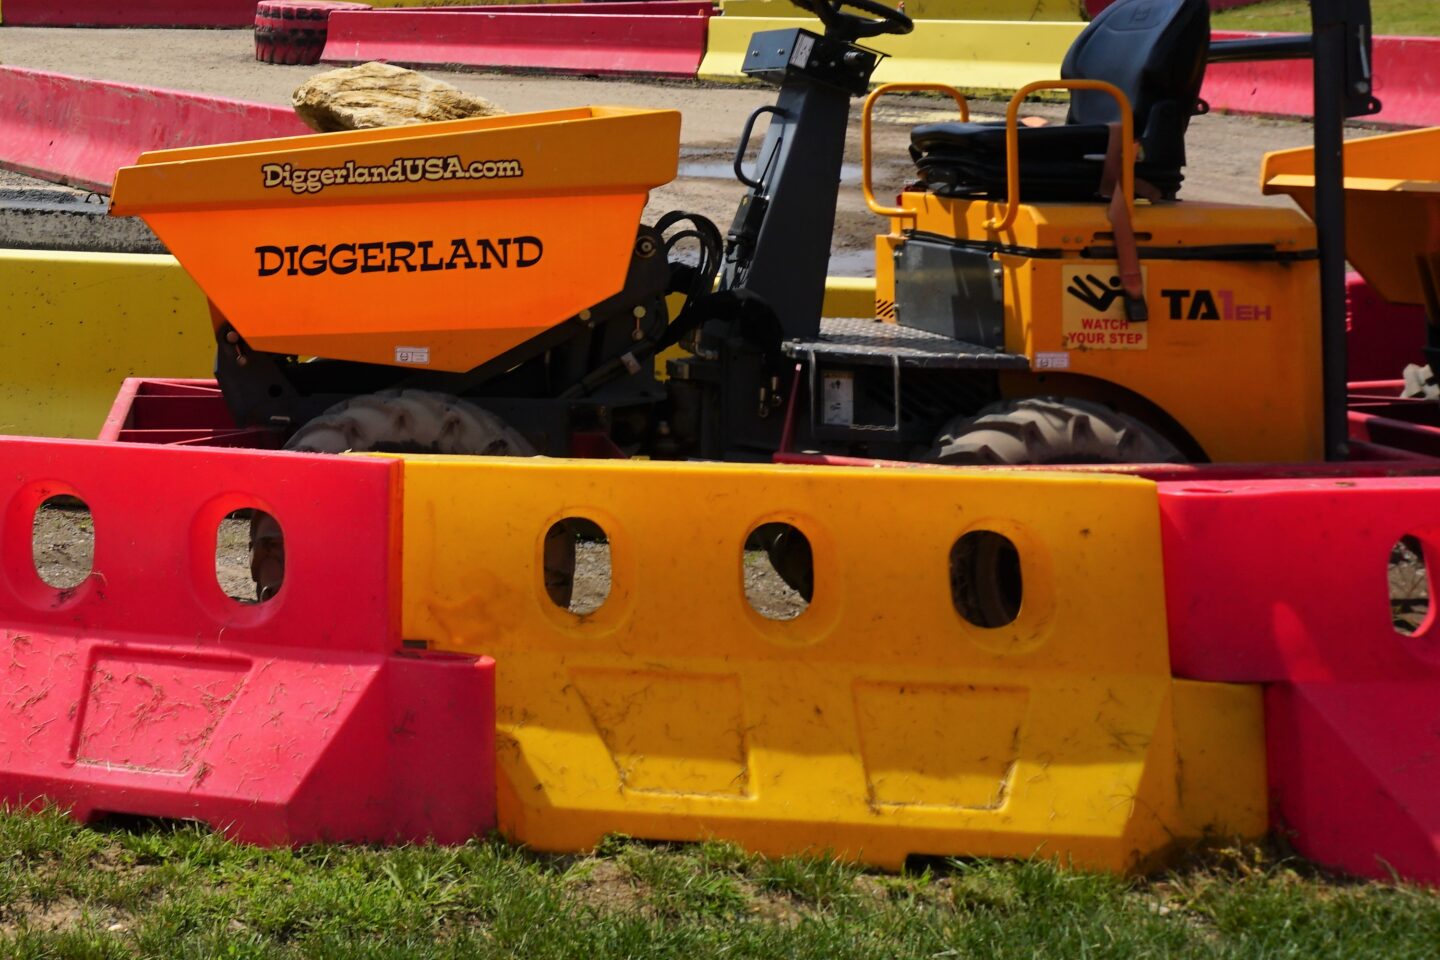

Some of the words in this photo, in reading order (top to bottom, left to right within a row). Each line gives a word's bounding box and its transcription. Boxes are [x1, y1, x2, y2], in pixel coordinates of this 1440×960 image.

[262, 155, 523, 193] DiggerlandUSA.com
[254, 235, 544, 277] DIGGERLAND
[1081, 318, 1129, 330] WATCH
[1068, 332, 1105, 344] YOUR
[1109, 332, 1143, 345] STEP
